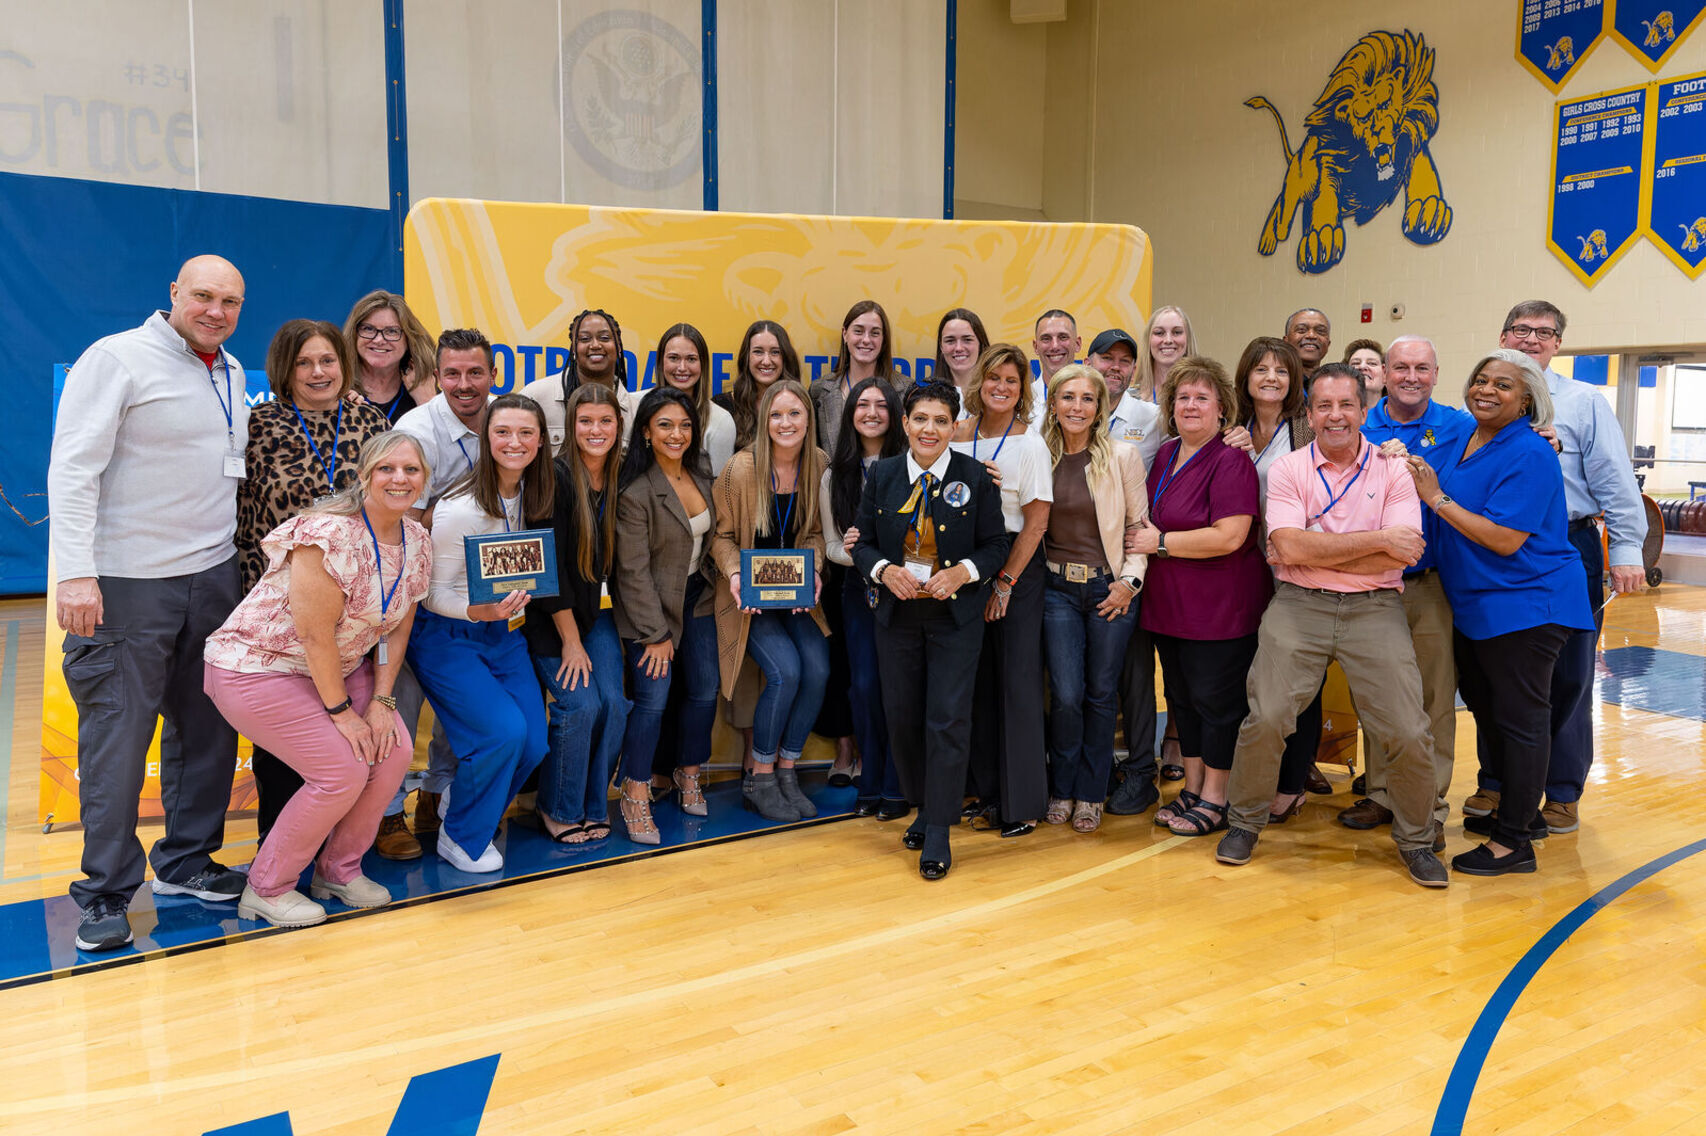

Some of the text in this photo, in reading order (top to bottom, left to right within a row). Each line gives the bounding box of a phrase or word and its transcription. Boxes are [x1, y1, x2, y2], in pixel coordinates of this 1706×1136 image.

[1544, 7, 1560, 19] 2013
[1564, 2, 1580, 14] 2014
[1524, 22, 1540, 34] 2017
[1563, 92, 1641, 117] GIRLS CROSS COUNTRY
[1660, 102, 1703, 118] 2002 2003
[1562, 113, 1642, 136] 1990 1991 1992 1993
[1580, 132, 1598, 143] 2007
[1622, 123, 1641, 134] 2010
[1656, 168, 1676, 179] 2016
